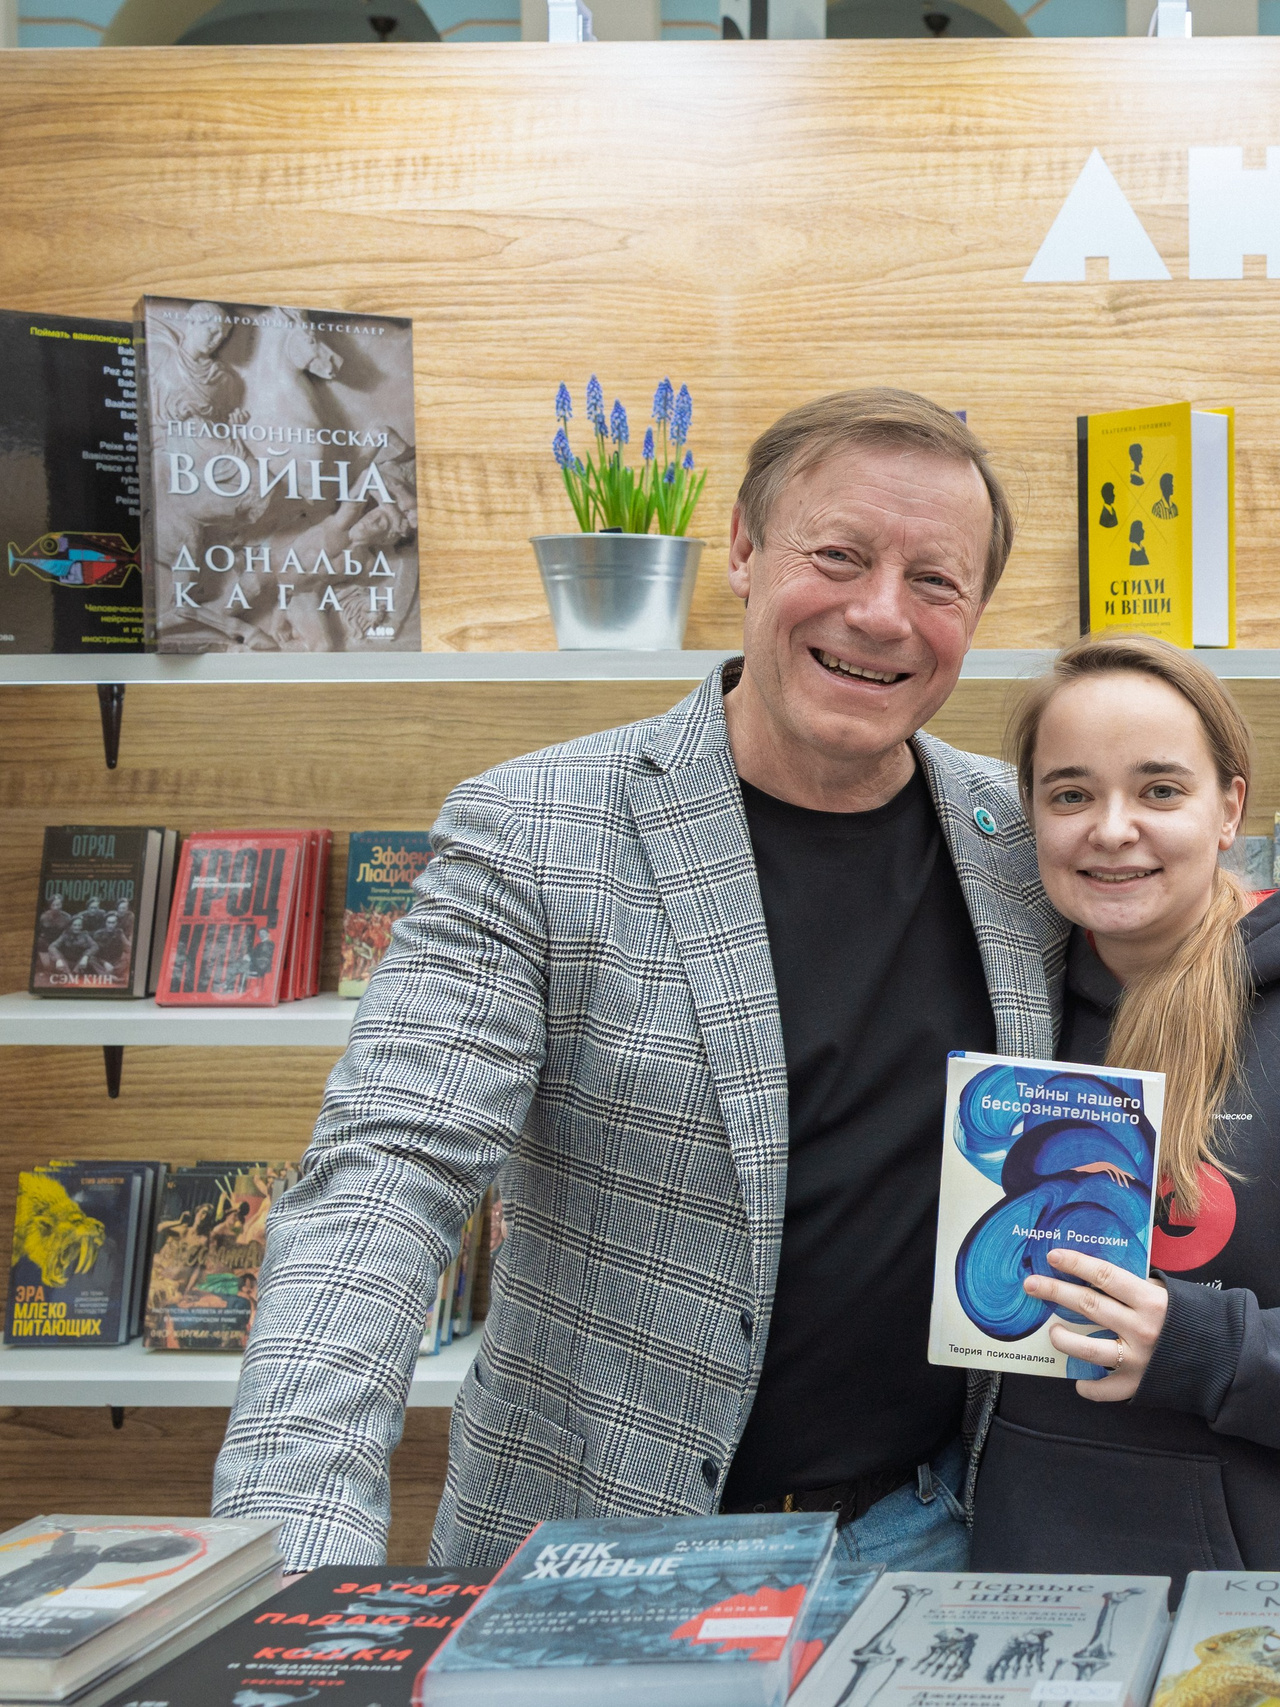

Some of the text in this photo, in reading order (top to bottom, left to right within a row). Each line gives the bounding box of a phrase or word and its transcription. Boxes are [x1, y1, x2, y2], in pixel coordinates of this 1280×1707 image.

[30, 327, 71, 339] Поймать
[301, 322, 385, 336] БЕСТСЕЛЛЕР
[166, 420, 389, 448] ПЕЛОПОННЕССКАЯ
[167, 446, 396, 504] ВОЙНА
[171, 544, 396, 577] ДОНАЛЬД
[1110, 578, 1165, 596] СТИХИ
[174, 582, 397, 612] КАГАН
[1105, 598, 1171, 616] И ВЕЩИ
[72, 834, 115, 858] ОТРЯД
[45, 879, 135, 901] ОТМОРОЗКОВ
[183, 847, 286, 929] ТРОЦ
[49, 973, 113, 985] СЭМ КИН
[1016, 1081, 1141, 1110] Тайны нашего
[981, 1094, 1140, 1126] бессознательного
[1012, 1223, 1129, 1247] Андрей Россохин
[15, 1285, 45, 1302] ЭРА
[14, 1302, 67, 1319] МЛЕКО
[12, 1318, 102, 1337] ПИТАЮЩИХ
[948, 1343, 1056, 1364] Теория психоанализа
[535, 1542, 620, 1561] КАК
[521, 1557, 686, 1581] ЖИВЫЕ
[332, 1583, 490, 1596] ЗАГАДК
[951, 1580, 1095, 1594] Первые
[969, 1594, 1063, 1603] шаги
[253, 1612, 465, 1629] ПАДАЮЩ
[253, 1646, 413, 1661] КОШКИ
[245, 1662, 403, 1672] ФУНДАМЕНТАЛЬНАЯ
[275, 1669, 339, 1677] ФИЗИКА
